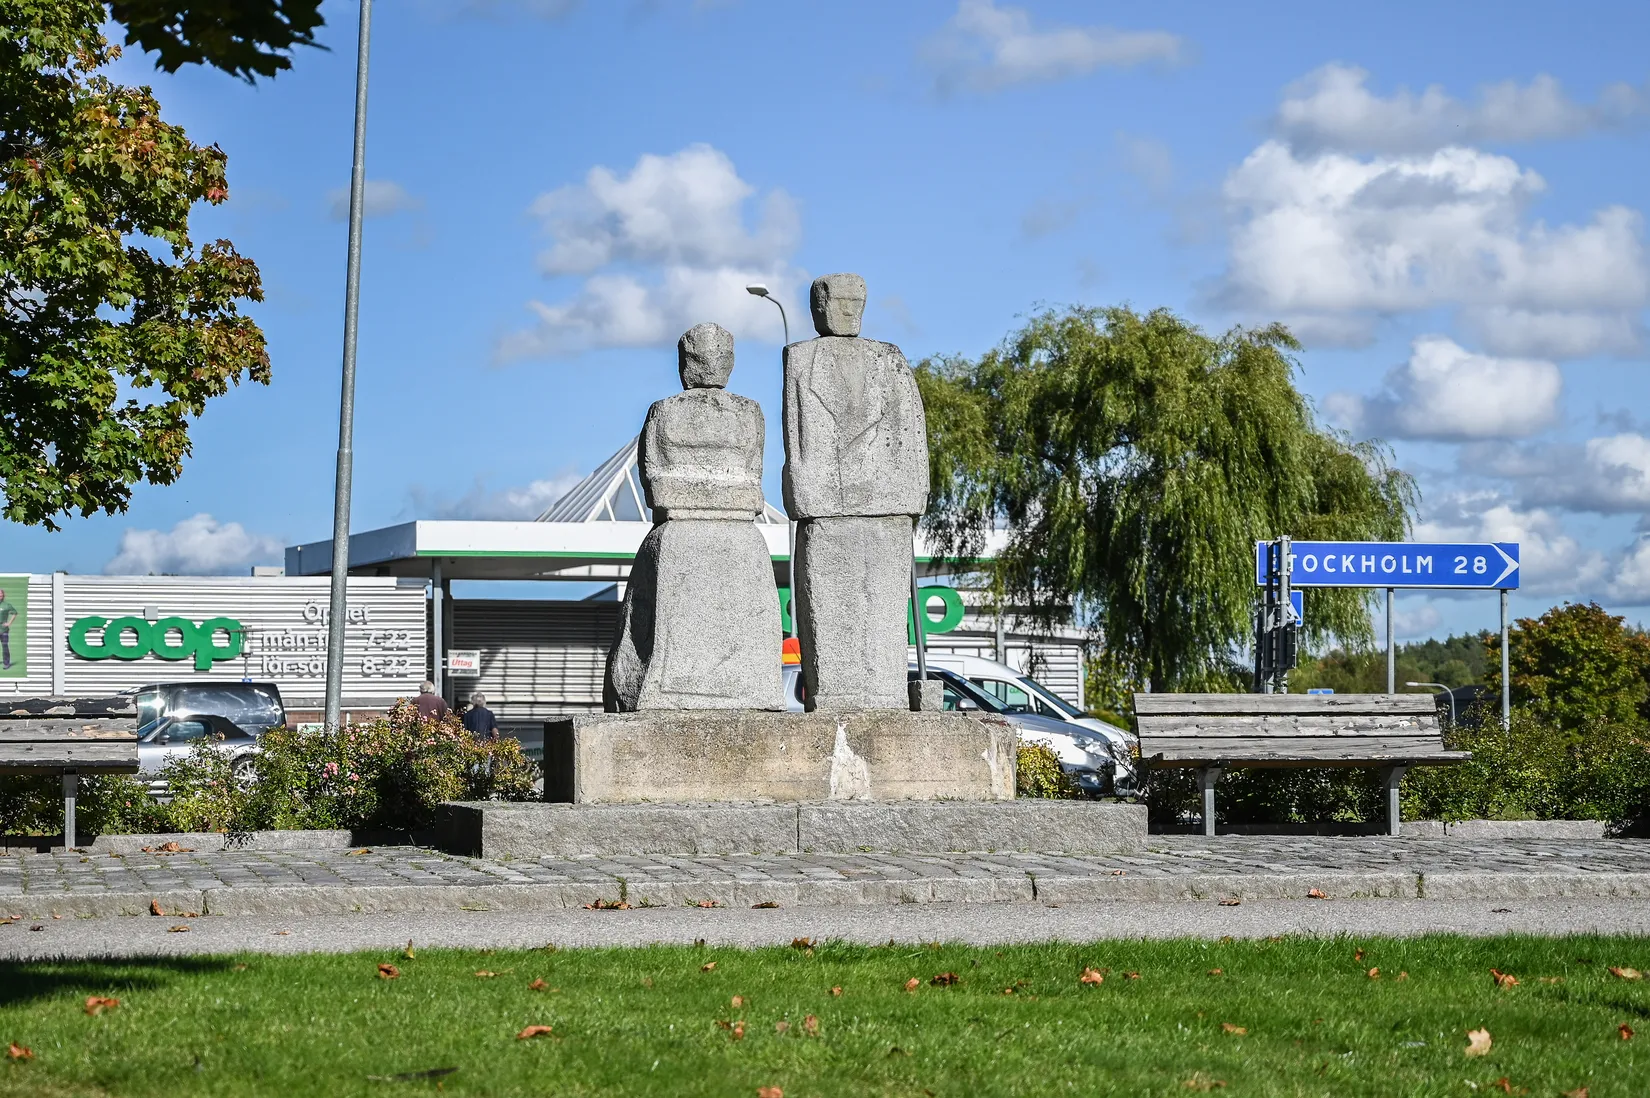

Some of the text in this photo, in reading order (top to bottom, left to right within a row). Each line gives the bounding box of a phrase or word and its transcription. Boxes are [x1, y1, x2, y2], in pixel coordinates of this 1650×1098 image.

[1273, 554, 1488, 574] TOCKHOLM 28
[303, 599, 371, 626] Öpet
[68, 615, 243, 671] coop
[364, 630, 411, 647] 7-22
[362, 656, 411, 674] 8-22
[451, 659, 473, 668] Uttag
